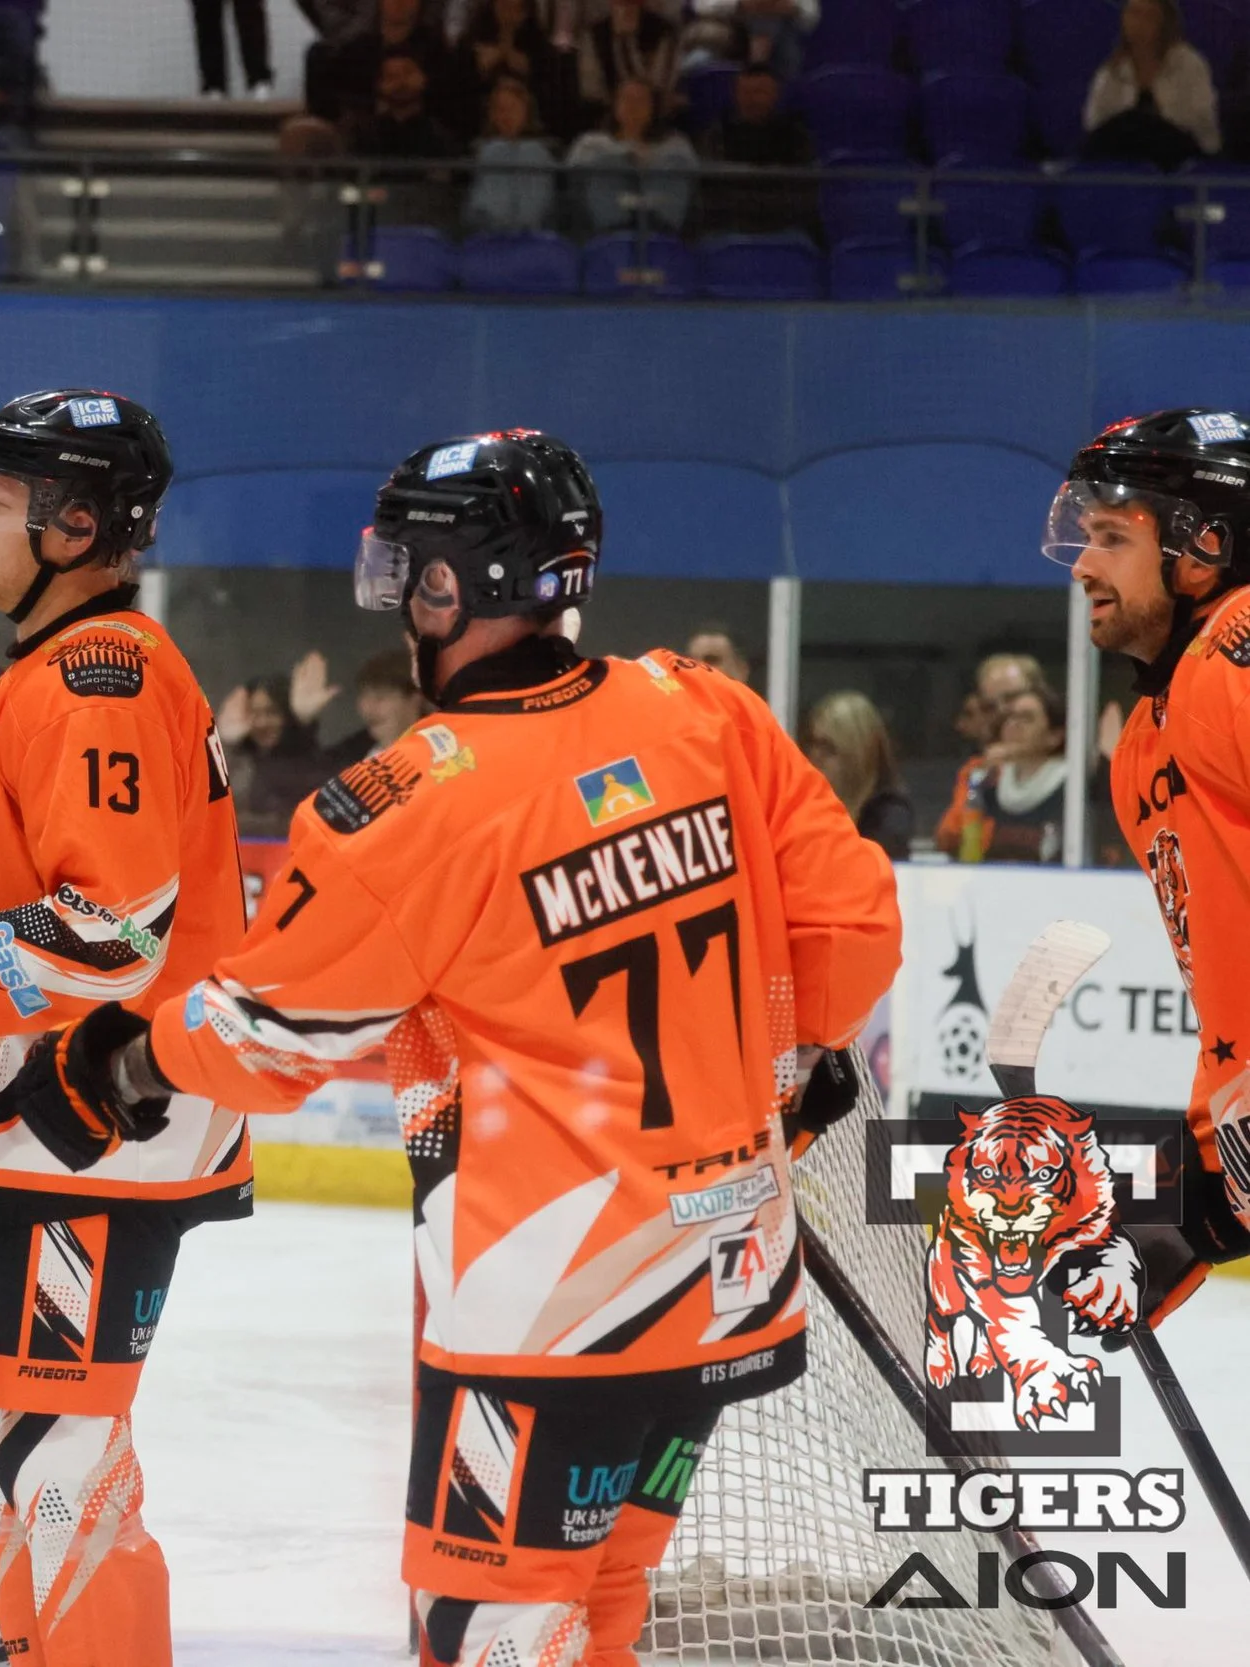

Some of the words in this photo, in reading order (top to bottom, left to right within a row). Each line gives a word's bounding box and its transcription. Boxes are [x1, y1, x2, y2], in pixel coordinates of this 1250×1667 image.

[78, 401, 114, 414] ICE
[82, 413, 118, 426] RINK
[1198, 414, 1235, 429] ICE
[1206, 427, 1243, 440] RINK
[443, 445, 475, 460] ICE
[437, 460, 471, 474] RINK
[562, 568, 583, 596] 77
[80, 668, 128, 676] BARBERS
[73, 677, 136, 690] SHROPSHIRE
[97, 685, 114, 693] LTD
[81, 748, 140, 815] 13
[534, 804, 733, 936] McKENZIE
[560, 898, 745, 1131] 77
[653, 1131, 770, 1179] TRUE
[17, 1365, 88, 1382] FIVEON3
[702, 1366, 726, 1384] GTS
[563, 1510, 586, 1525] UK
